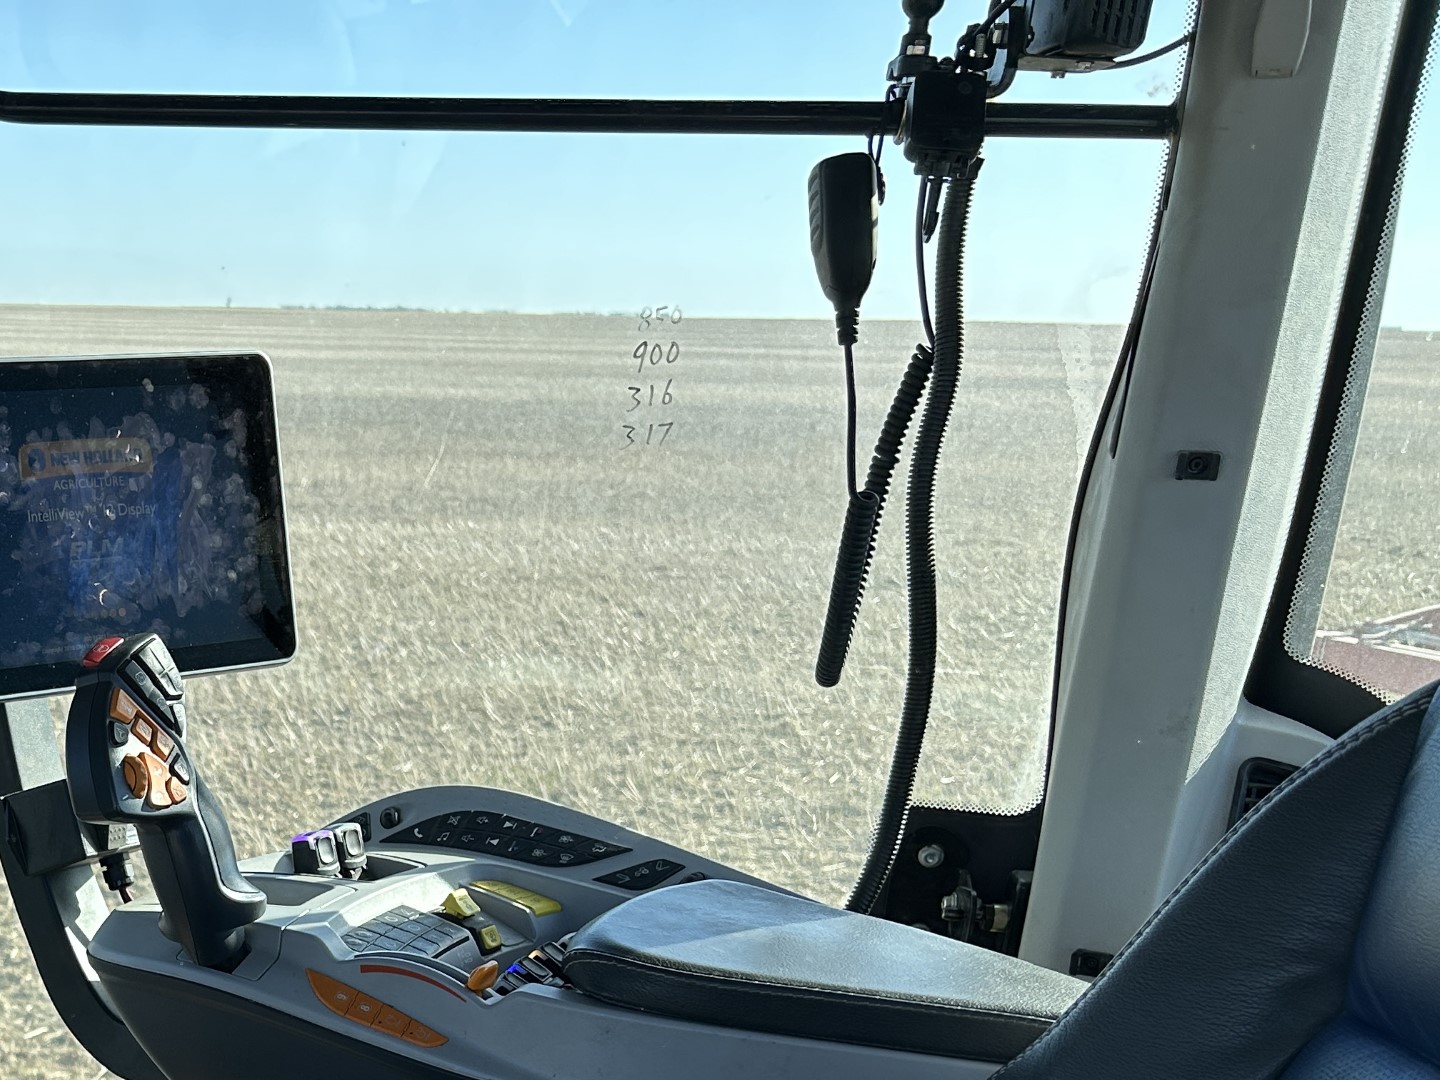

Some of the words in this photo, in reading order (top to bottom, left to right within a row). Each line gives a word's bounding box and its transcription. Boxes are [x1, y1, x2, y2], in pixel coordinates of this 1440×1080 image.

[638, 304, 683, 332] 850
[633, 340, 680, 374] 900
[626, 378, 673, 413] 316
[619, 422, 674, 451] 317
[50, 451, 80, 467] NEW
[83, 447, 142, 465] HOLLAND
[53, 476, 126, 491] AGRICULTURE
[117, 503, 157, 518] Display
[71, 538, 125, 560] PLM
